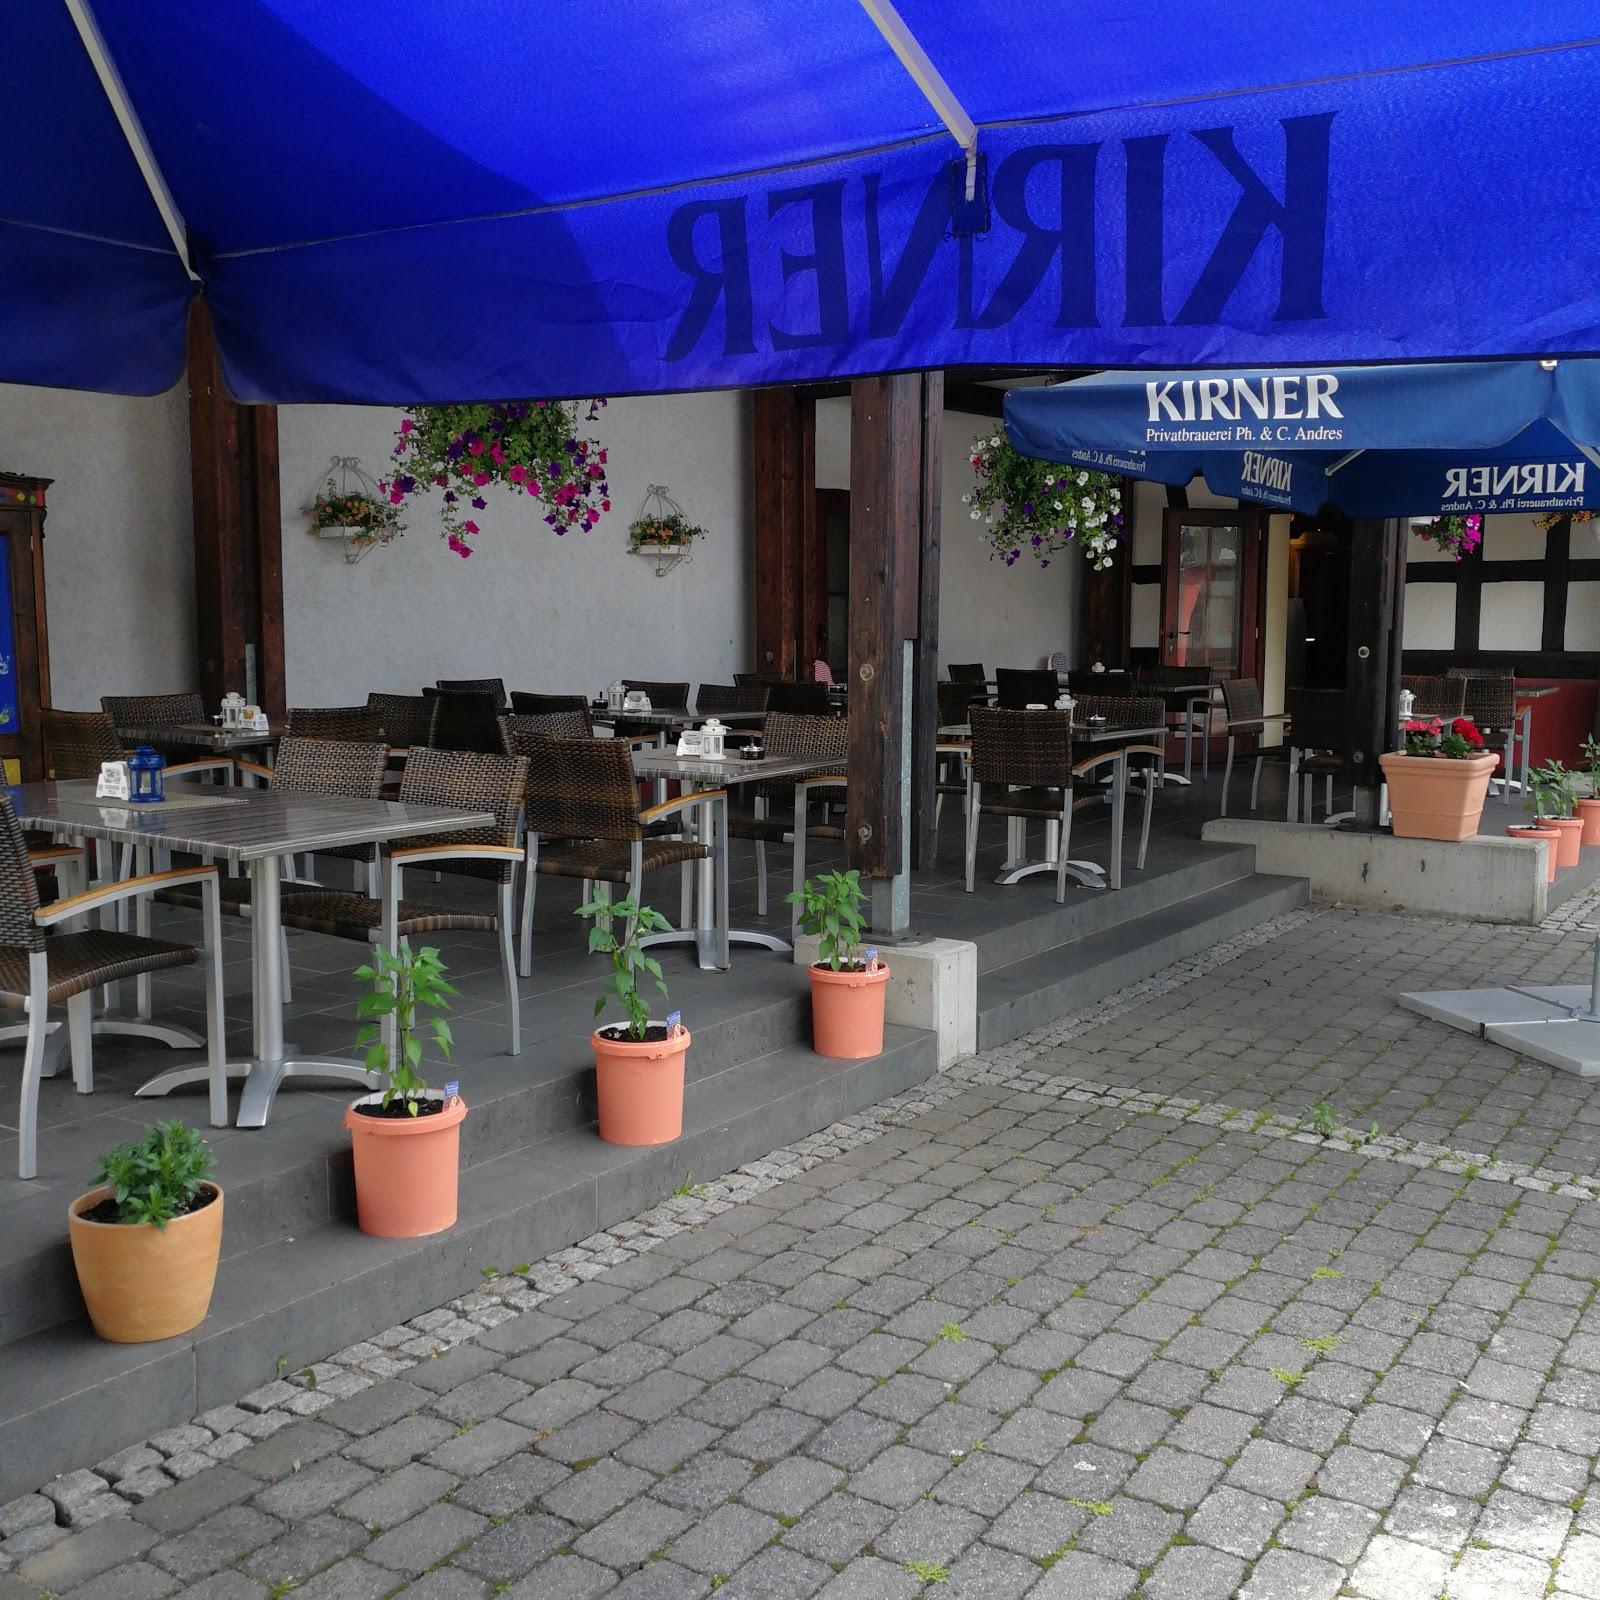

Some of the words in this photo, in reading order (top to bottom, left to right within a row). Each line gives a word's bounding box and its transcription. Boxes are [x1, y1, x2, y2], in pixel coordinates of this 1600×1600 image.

[1146, 374, 1344, 422] KIRNER
[1146, 427, 1232, 442] Privatbrauerei
[1235, 427, 1255, 441] Ph.
[1260, 427, 1273, 440] &
[1277, 427, 1291, 440] C.
[1295, 426, 1343, 440] Andres
